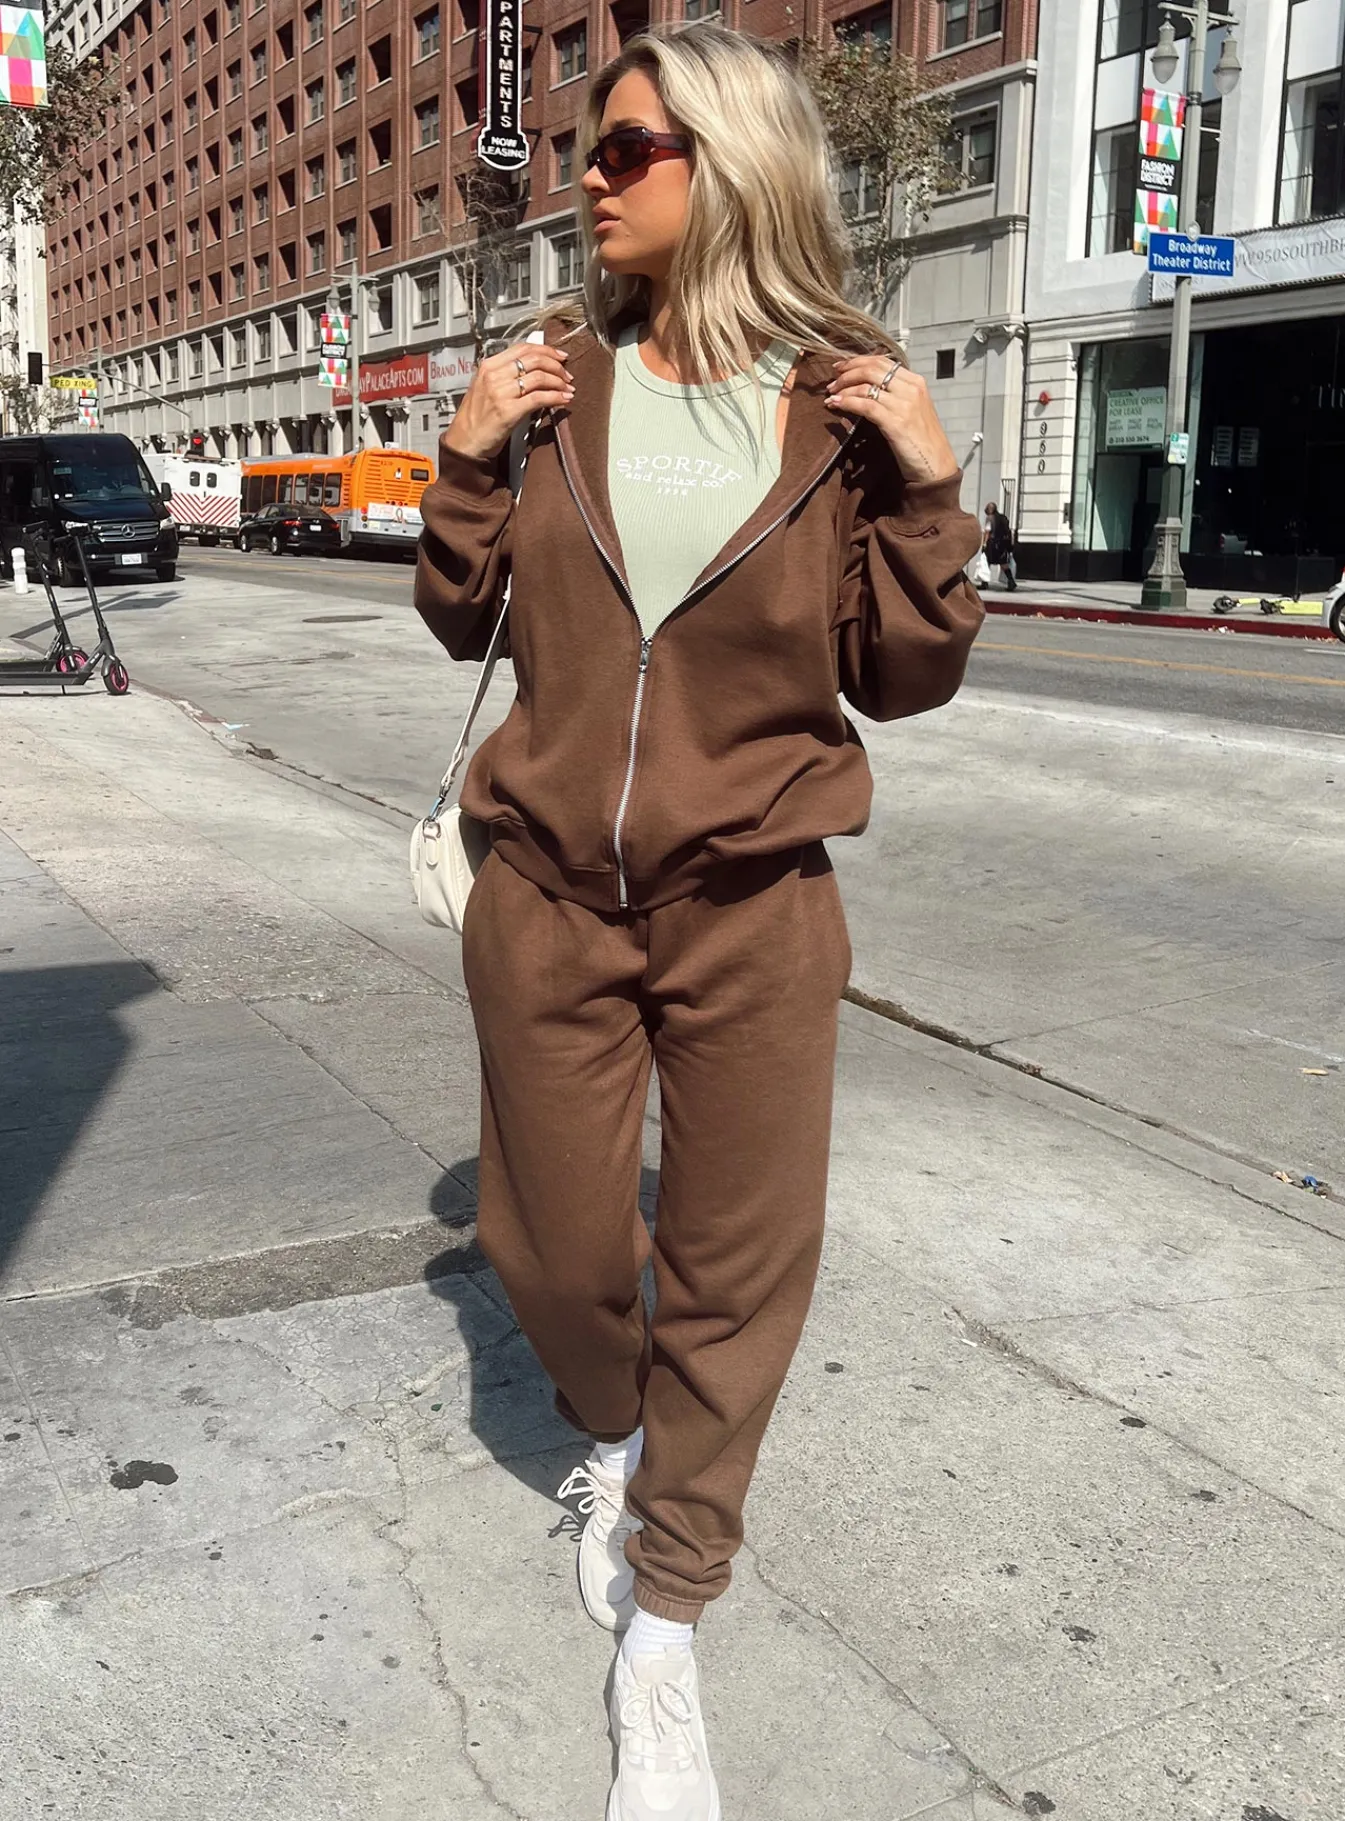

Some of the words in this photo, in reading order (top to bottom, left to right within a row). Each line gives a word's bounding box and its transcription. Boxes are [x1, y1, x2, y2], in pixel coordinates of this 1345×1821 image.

[491, 136, 518, 147] NOW
[481, 145, 527, 159] LEASING
[1141, 159, 1176, 176] FASHION
[1140, 169, 1175, 186] DISTRICT
[1168, 239, 1218, 258] Broadway
[1152, 253, 1191, 269] Theater
[1193, 256, 1231, 272] District
[54, 379, 71, 387] PED
[74, 380, 93, 388] XING
[1140, 395, 1164, 406] OFFICE
[616, 455, 743, 485] SPORTIF
[624, 472, 653, 482] and
[656, 474, 697, 487] relax
